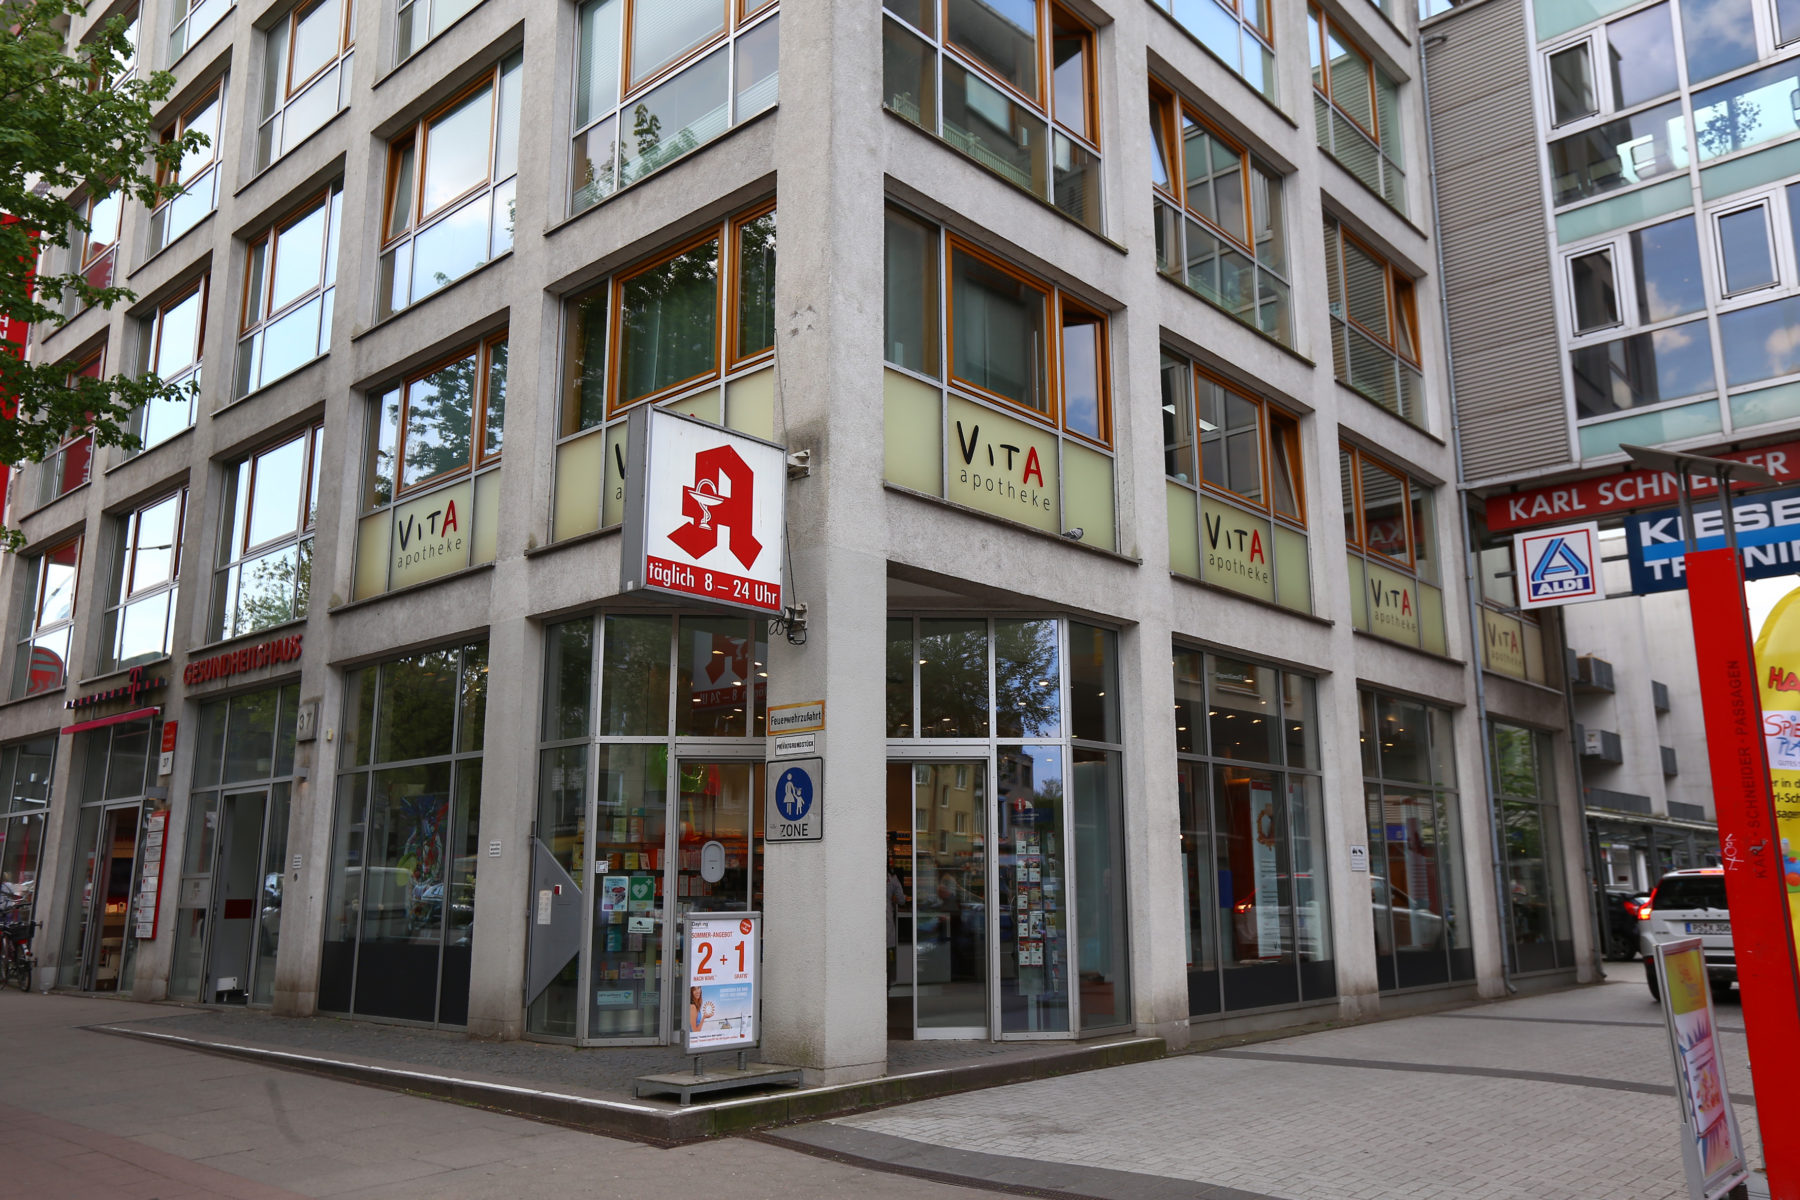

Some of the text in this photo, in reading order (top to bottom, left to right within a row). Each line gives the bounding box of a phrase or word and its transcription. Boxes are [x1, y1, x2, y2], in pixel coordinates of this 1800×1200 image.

[957, 421, 1043, 487] VITA
[960, 469, 1050, 511] apotheke
[1509, 451, 1790, 521] KARL SCHNEER
[399, 500, 457, 551] VITA
[1205, 512, 1264, 564] VITA
[397, 537, 462, 570] apotheke
[1209, 554, 1268, 584] apotheke
[649, 562, 695, 588] täglich
[704, 573, 713, 591] 8
[733, 580, 750, 599] 24
[755, 584, 777, 605] Uhr
[1371, 578, 1412, 616] VITA
[1538, 578, 1583, 595] ALDI
[1375, 611, 1417, 633] apotheke
[1488, 623, 1519, 654] VITA
[183, 634, 303, 685] GESUNDHEITSHAUS
[1727, 660, 1749, 735] PASSAGEN
[299, 712, 312, 729] 37
[770, 711, 822, 726] Feuerwehrzufahrt
[780, 823, 808, 837] ZONE
[697, 941, 745, 974] 2 + 1
